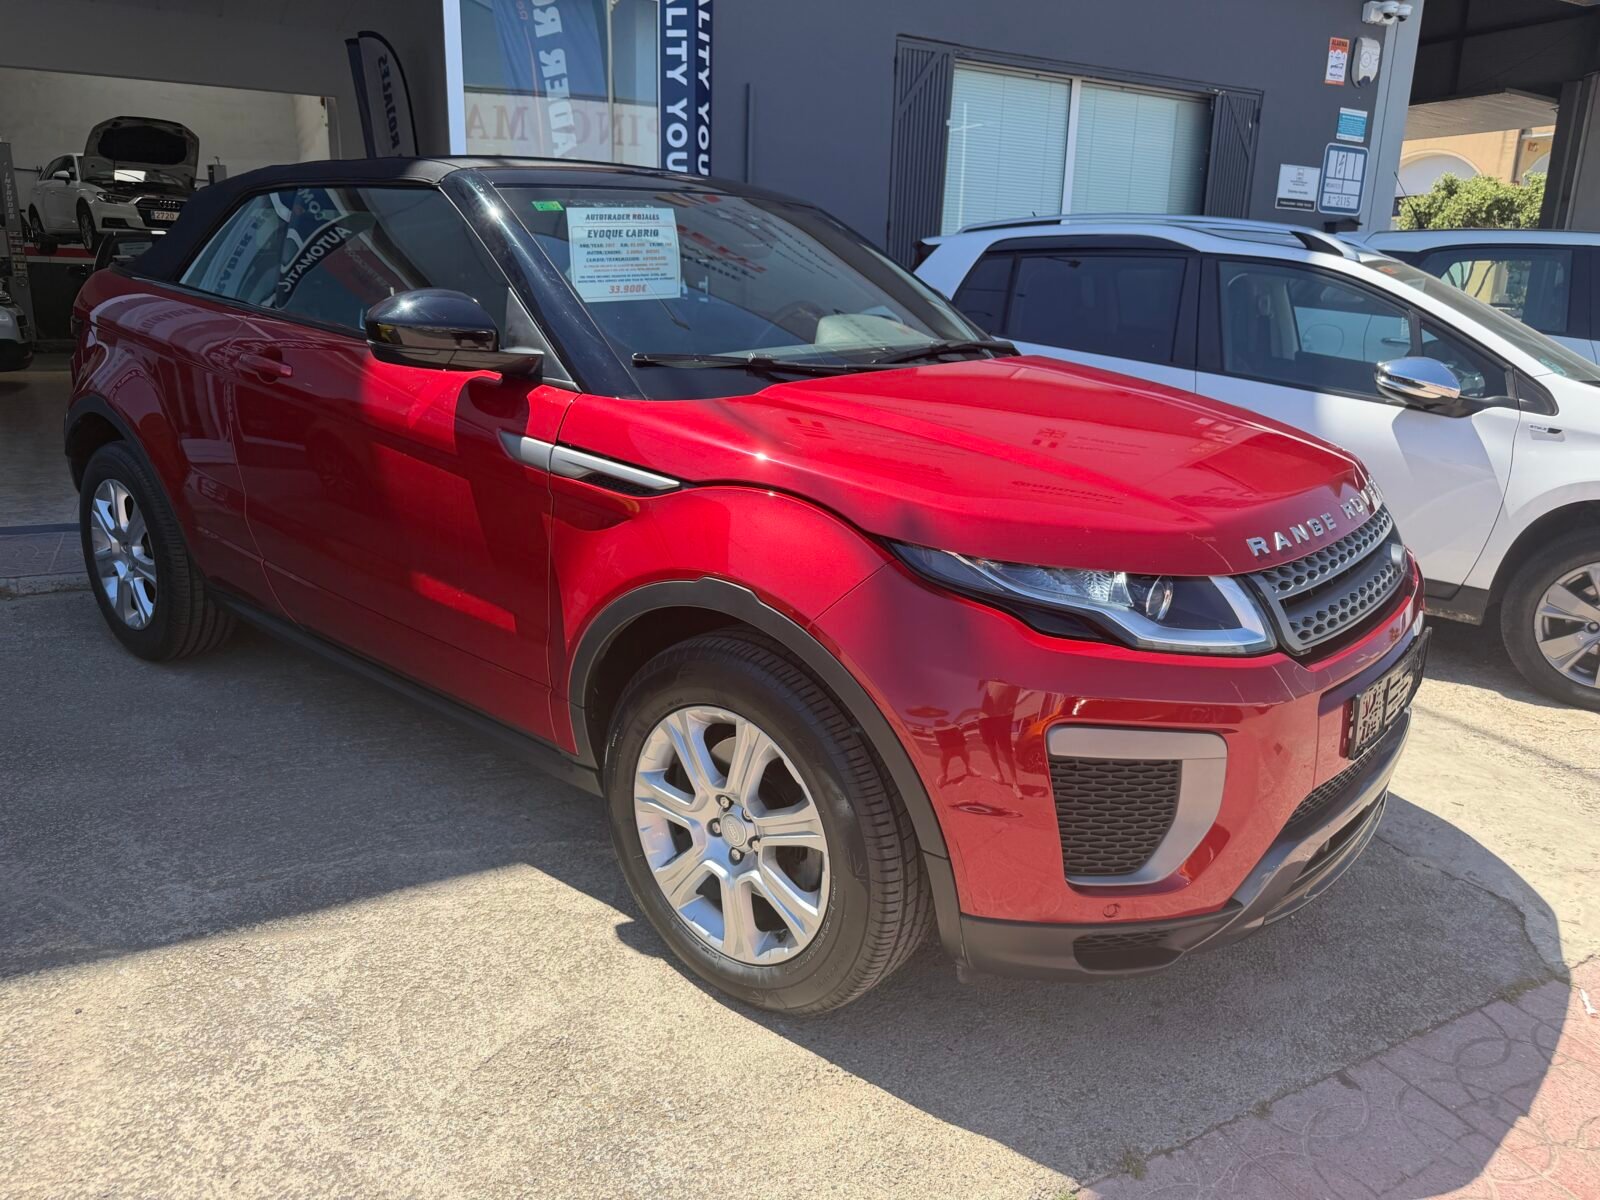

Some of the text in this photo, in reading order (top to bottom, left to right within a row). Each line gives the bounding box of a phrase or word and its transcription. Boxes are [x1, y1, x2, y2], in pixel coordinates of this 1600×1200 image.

[665, 0, 688, 87] LITY
[697, 0, 711, 90] LITY
[585, 213, 630, 221] AUTOTRADER
[587, 228, 660, 239] EVOQUE CABRIO
[608, 284, 647, 294] 33.900€
[1246, 511, 1338, 557] RANGE
